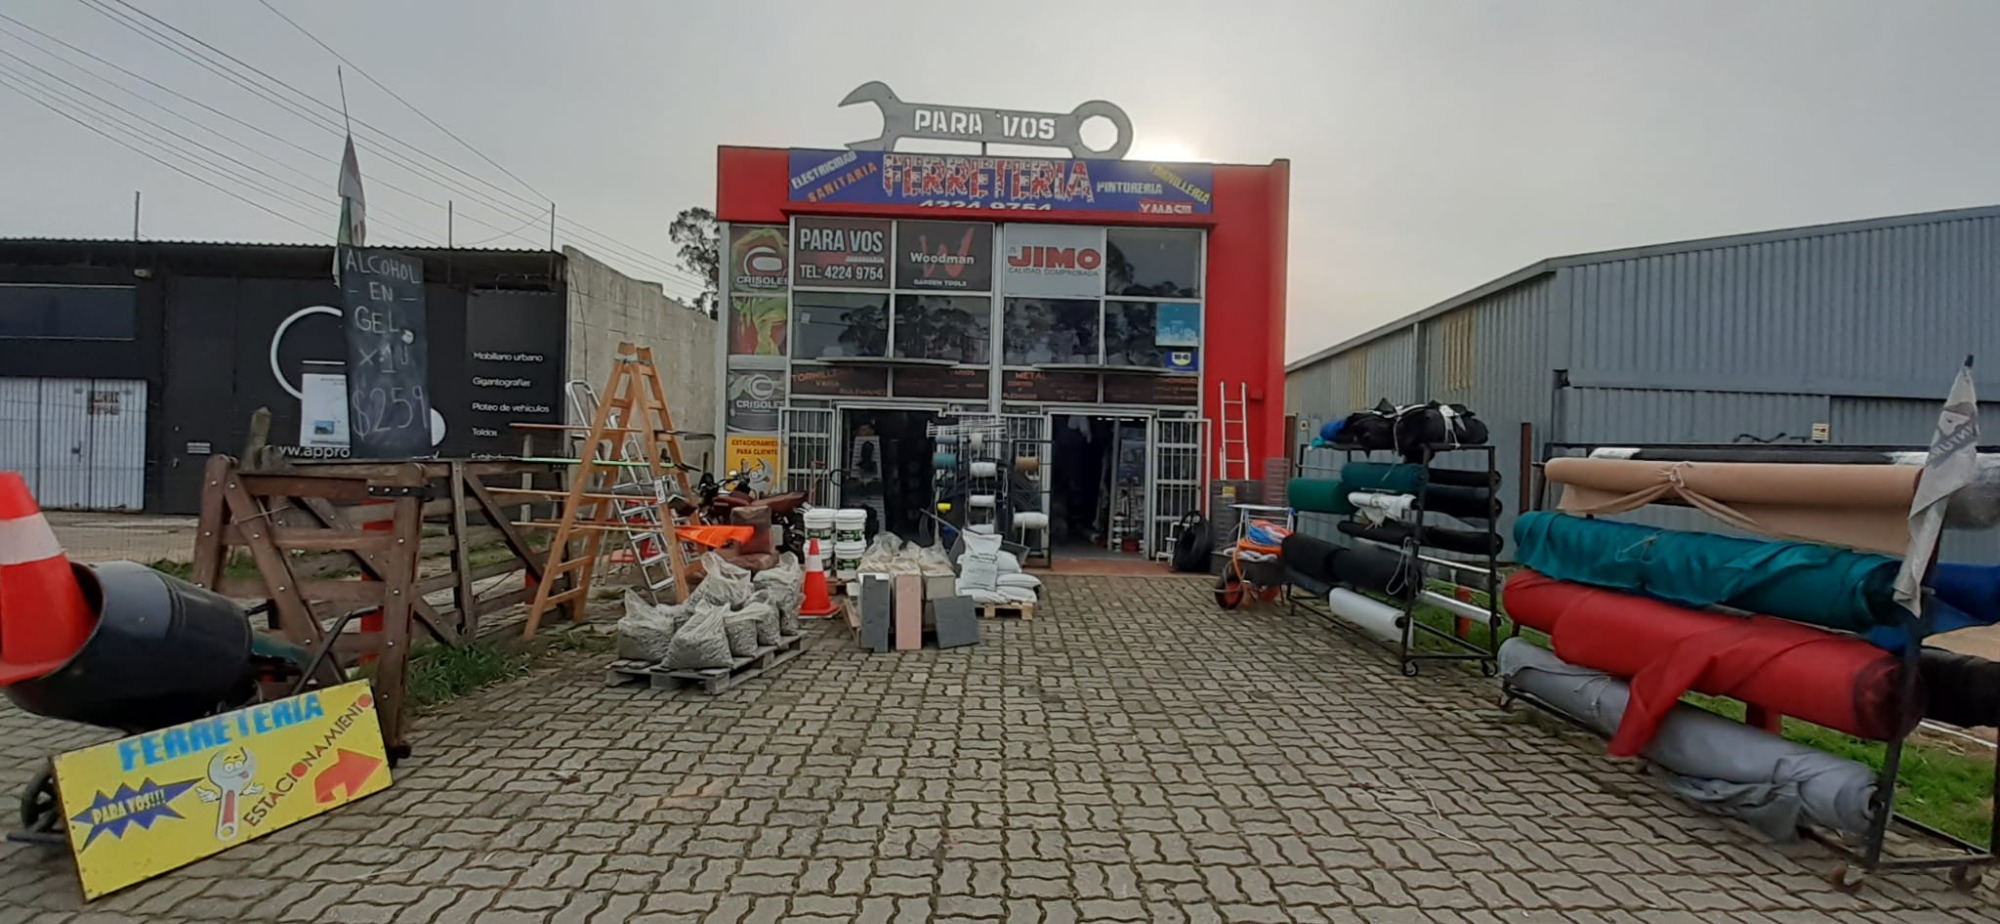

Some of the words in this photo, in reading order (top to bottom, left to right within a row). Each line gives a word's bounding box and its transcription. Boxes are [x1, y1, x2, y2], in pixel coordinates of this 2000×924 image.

[914, 109, 983, 135] PARA
[1002, 115, 1056, 140] VOS
[790, 151, 858, 190] ELECTRICIDAD
[806, 161, 879, 203] SANITARIA
[883, 153, 1095, 203] FERRETERIA
[1096, 181, 1163, 195] PINTURERIA
[800, 228, 845, 251] PARA
[850, 230, 884, 253] VOS
[345, 250, 421, 284] ALCOHOL
[910, 251, 975, 266] Woodman
[1007, 245, 1101, 270] JIMO
[800, 264, 822, 279] TEL:
[824, 265, 851, 280] 4224
[856, 266, 884, 281] 9754
[369, 281, 394, 301] EN
[354, 306, 399, 334] GEL
[473, 352, 512, 361] Mobiliario
[513, 354, 543, 362] urbano
[352, 385, 428, 440] $259
[472, 402, 498, 412] Ploteo
[499, 403, 511, 412] de
[117, 692, 324, 773] FERRETERIA
[242, 693, 374, 828] ESTACIONAMIENTO
[92, 801, 127, 826] PARA
[127, 788, 167, 815] VOS!!!
